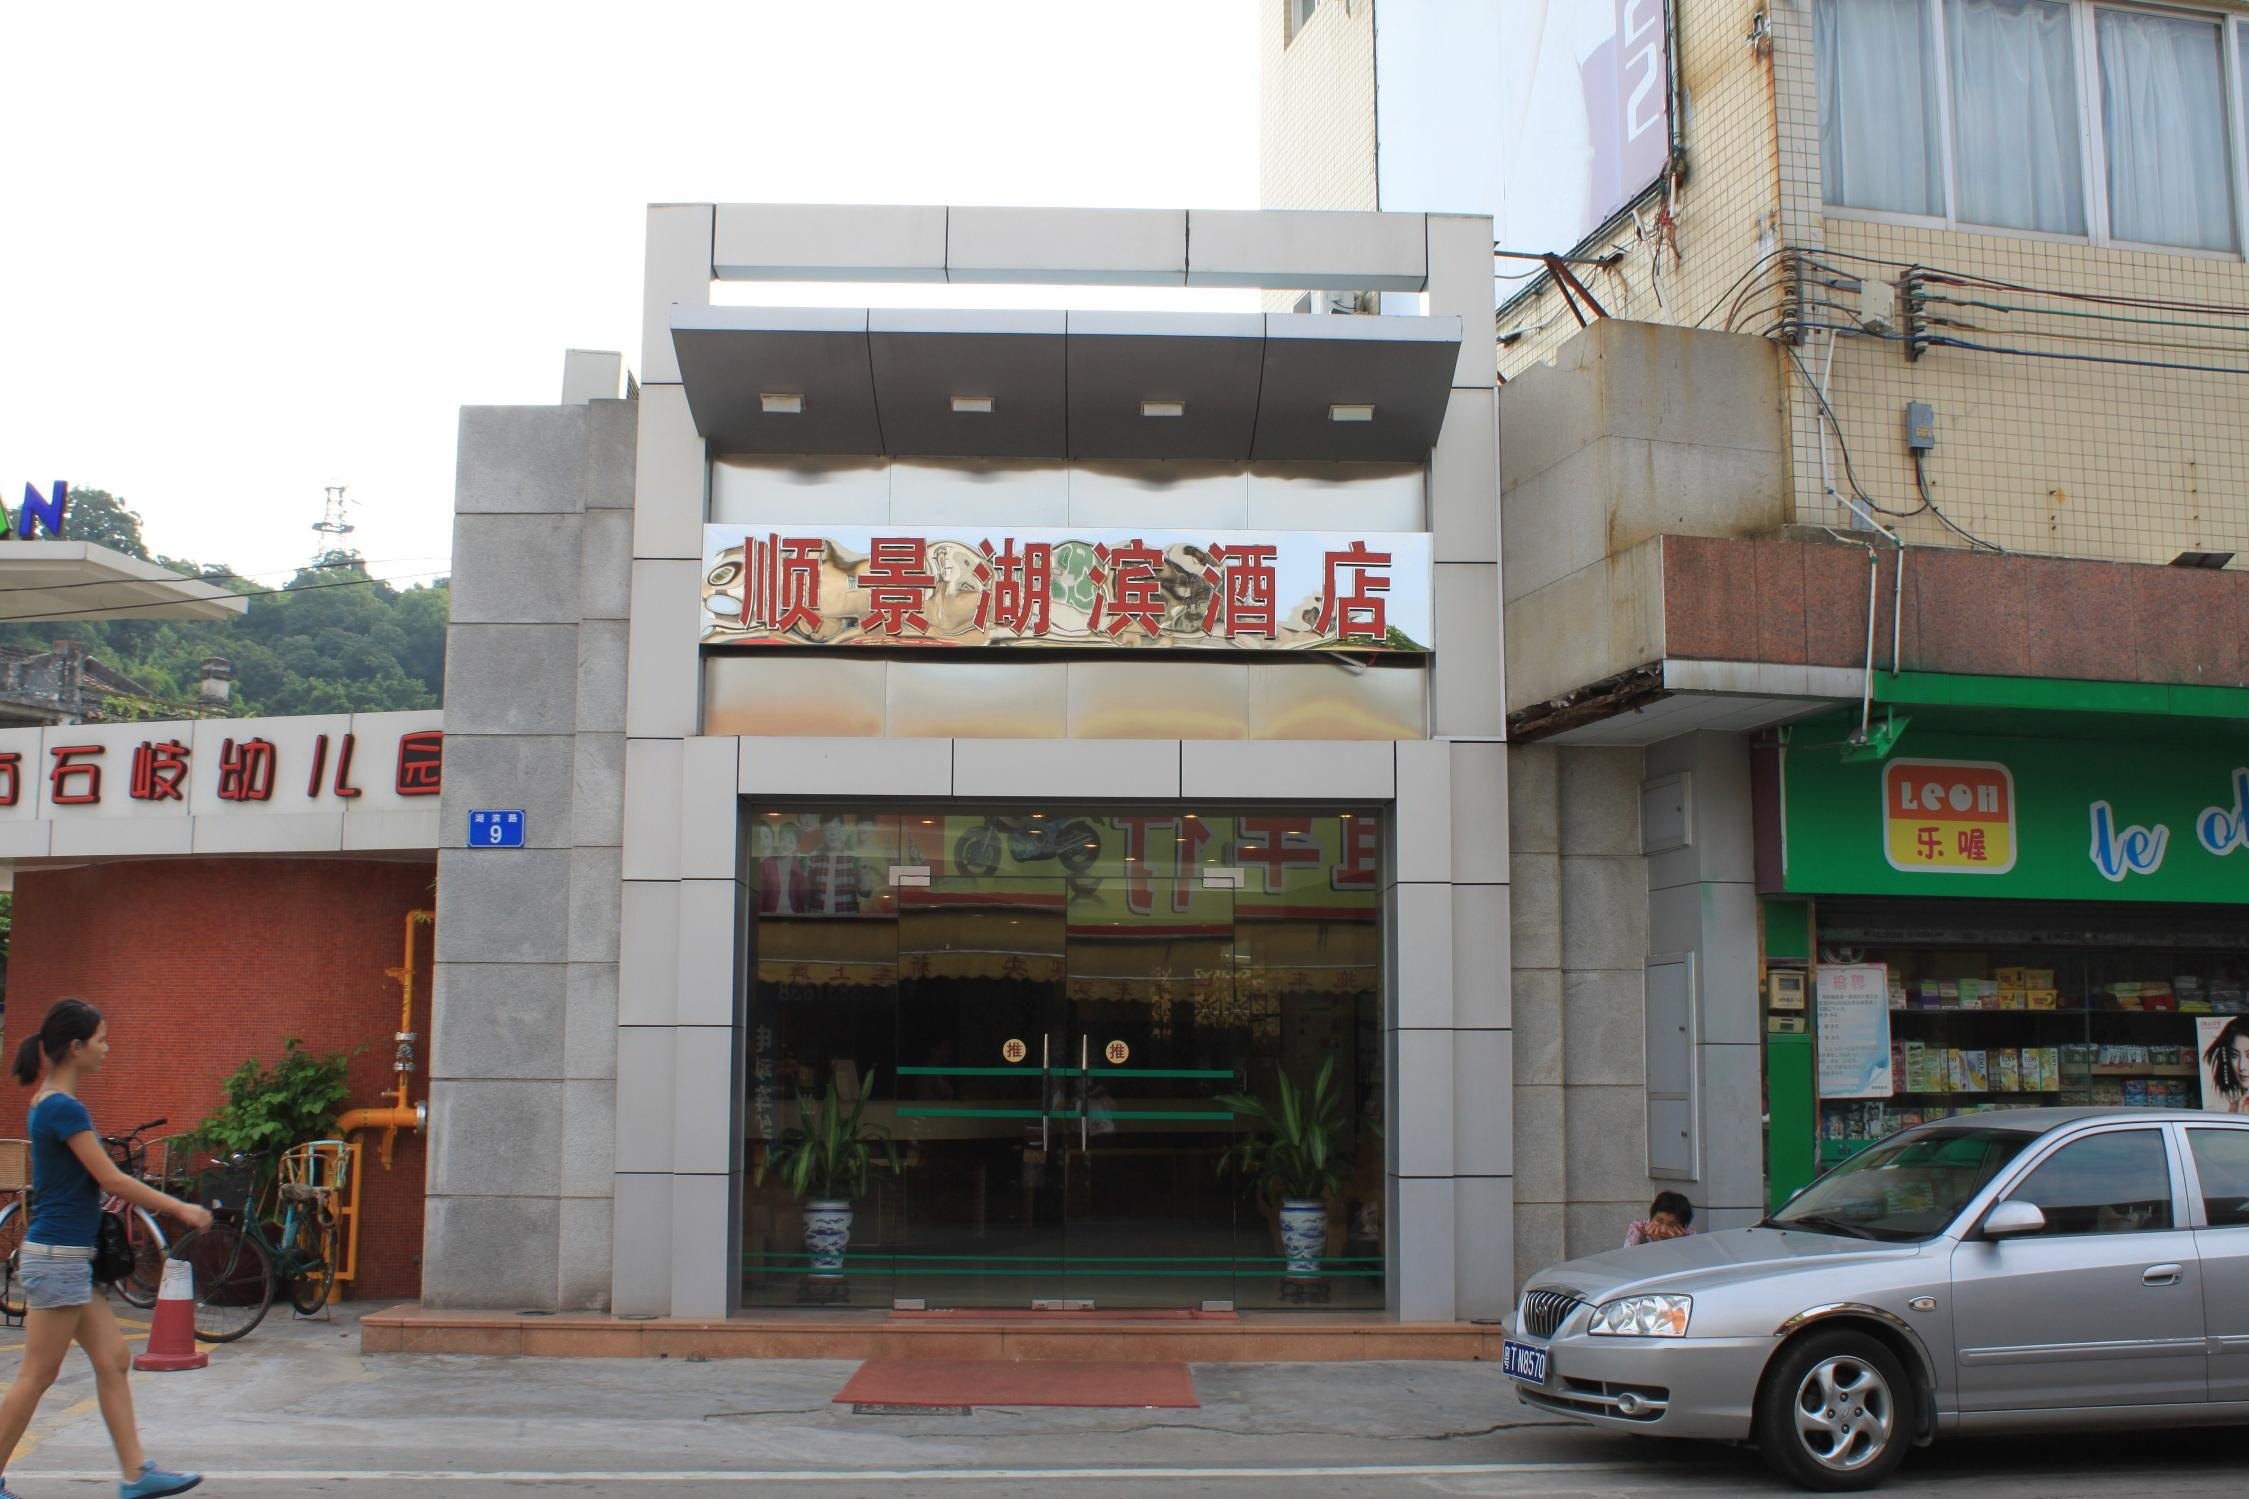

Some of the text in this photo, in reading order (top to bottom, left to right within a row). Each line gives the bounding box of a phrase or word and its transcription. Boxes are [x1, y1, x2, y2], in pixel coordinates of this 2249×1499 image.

[740, 531, 1393, 641] 顺景湖滨酒店
[490, 824, 502, 844] 9
[1916, 826, 1987, 861] 乐喔
[1007, 1042, 1022, 1058] 推
[1110, 1043, 1125, 1059] 推
